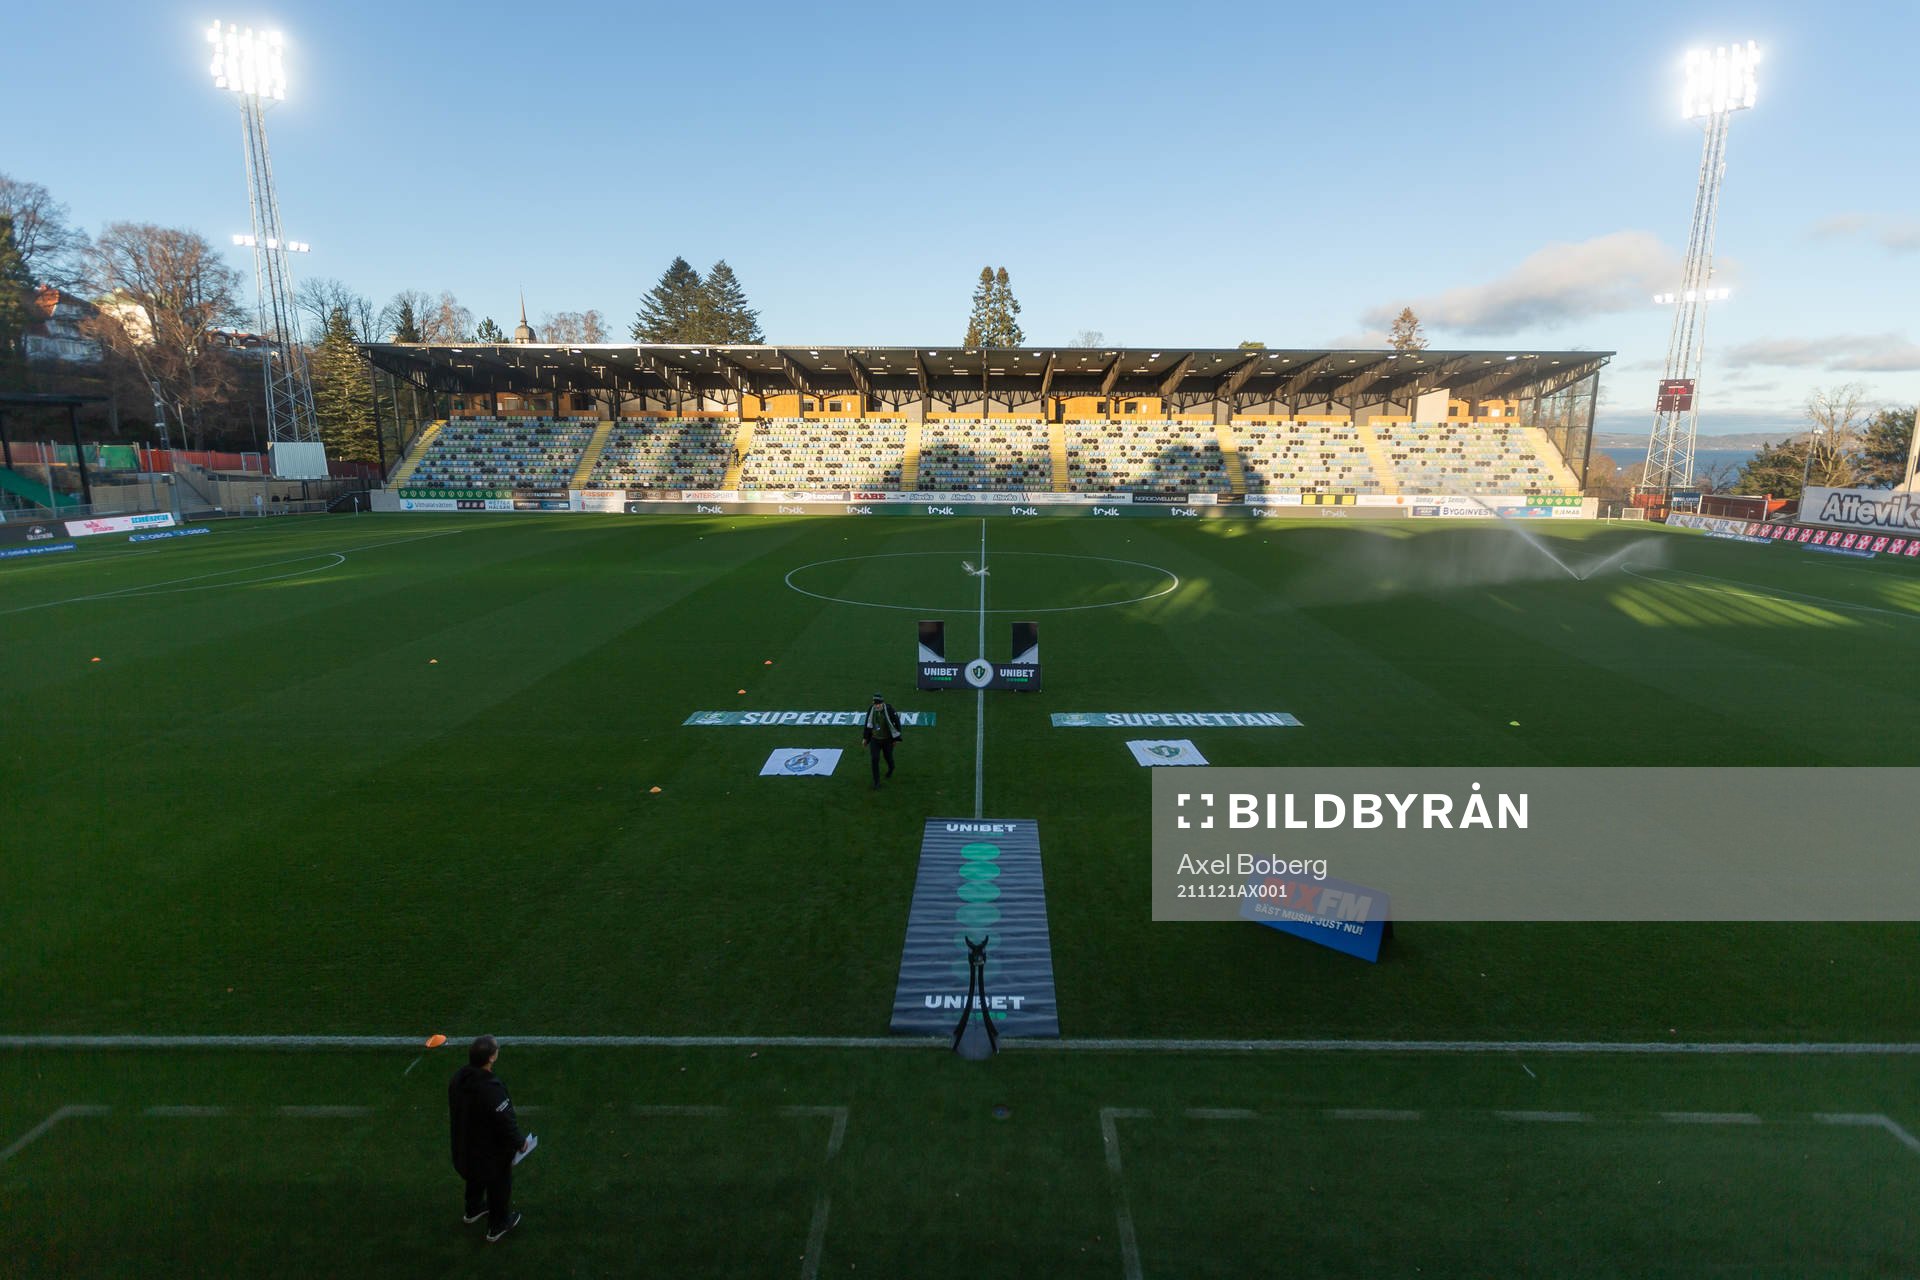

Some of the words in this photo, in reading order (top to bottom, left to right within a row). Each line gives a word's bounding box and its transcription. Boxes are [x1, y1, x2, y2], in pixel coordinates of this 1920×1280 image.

[692, 492, 735, 500] INTERSPORT
[924, 668, 958, 676] UNIBET
[1000, 669, 1035, 678] UNIBET
[740, 711, 919, 725] SUPERETN
[1104, 712, 1285, 726] SUPERETTAN
[946, 824, 1017, 833] UNIBET
[1254, 902, 1281, 916] BÄST
[1282, 909, 1315, 925] MUSIK
[1315, 916, 1342, 930] JUST
[1343, 923, 1364, 936] NU!
